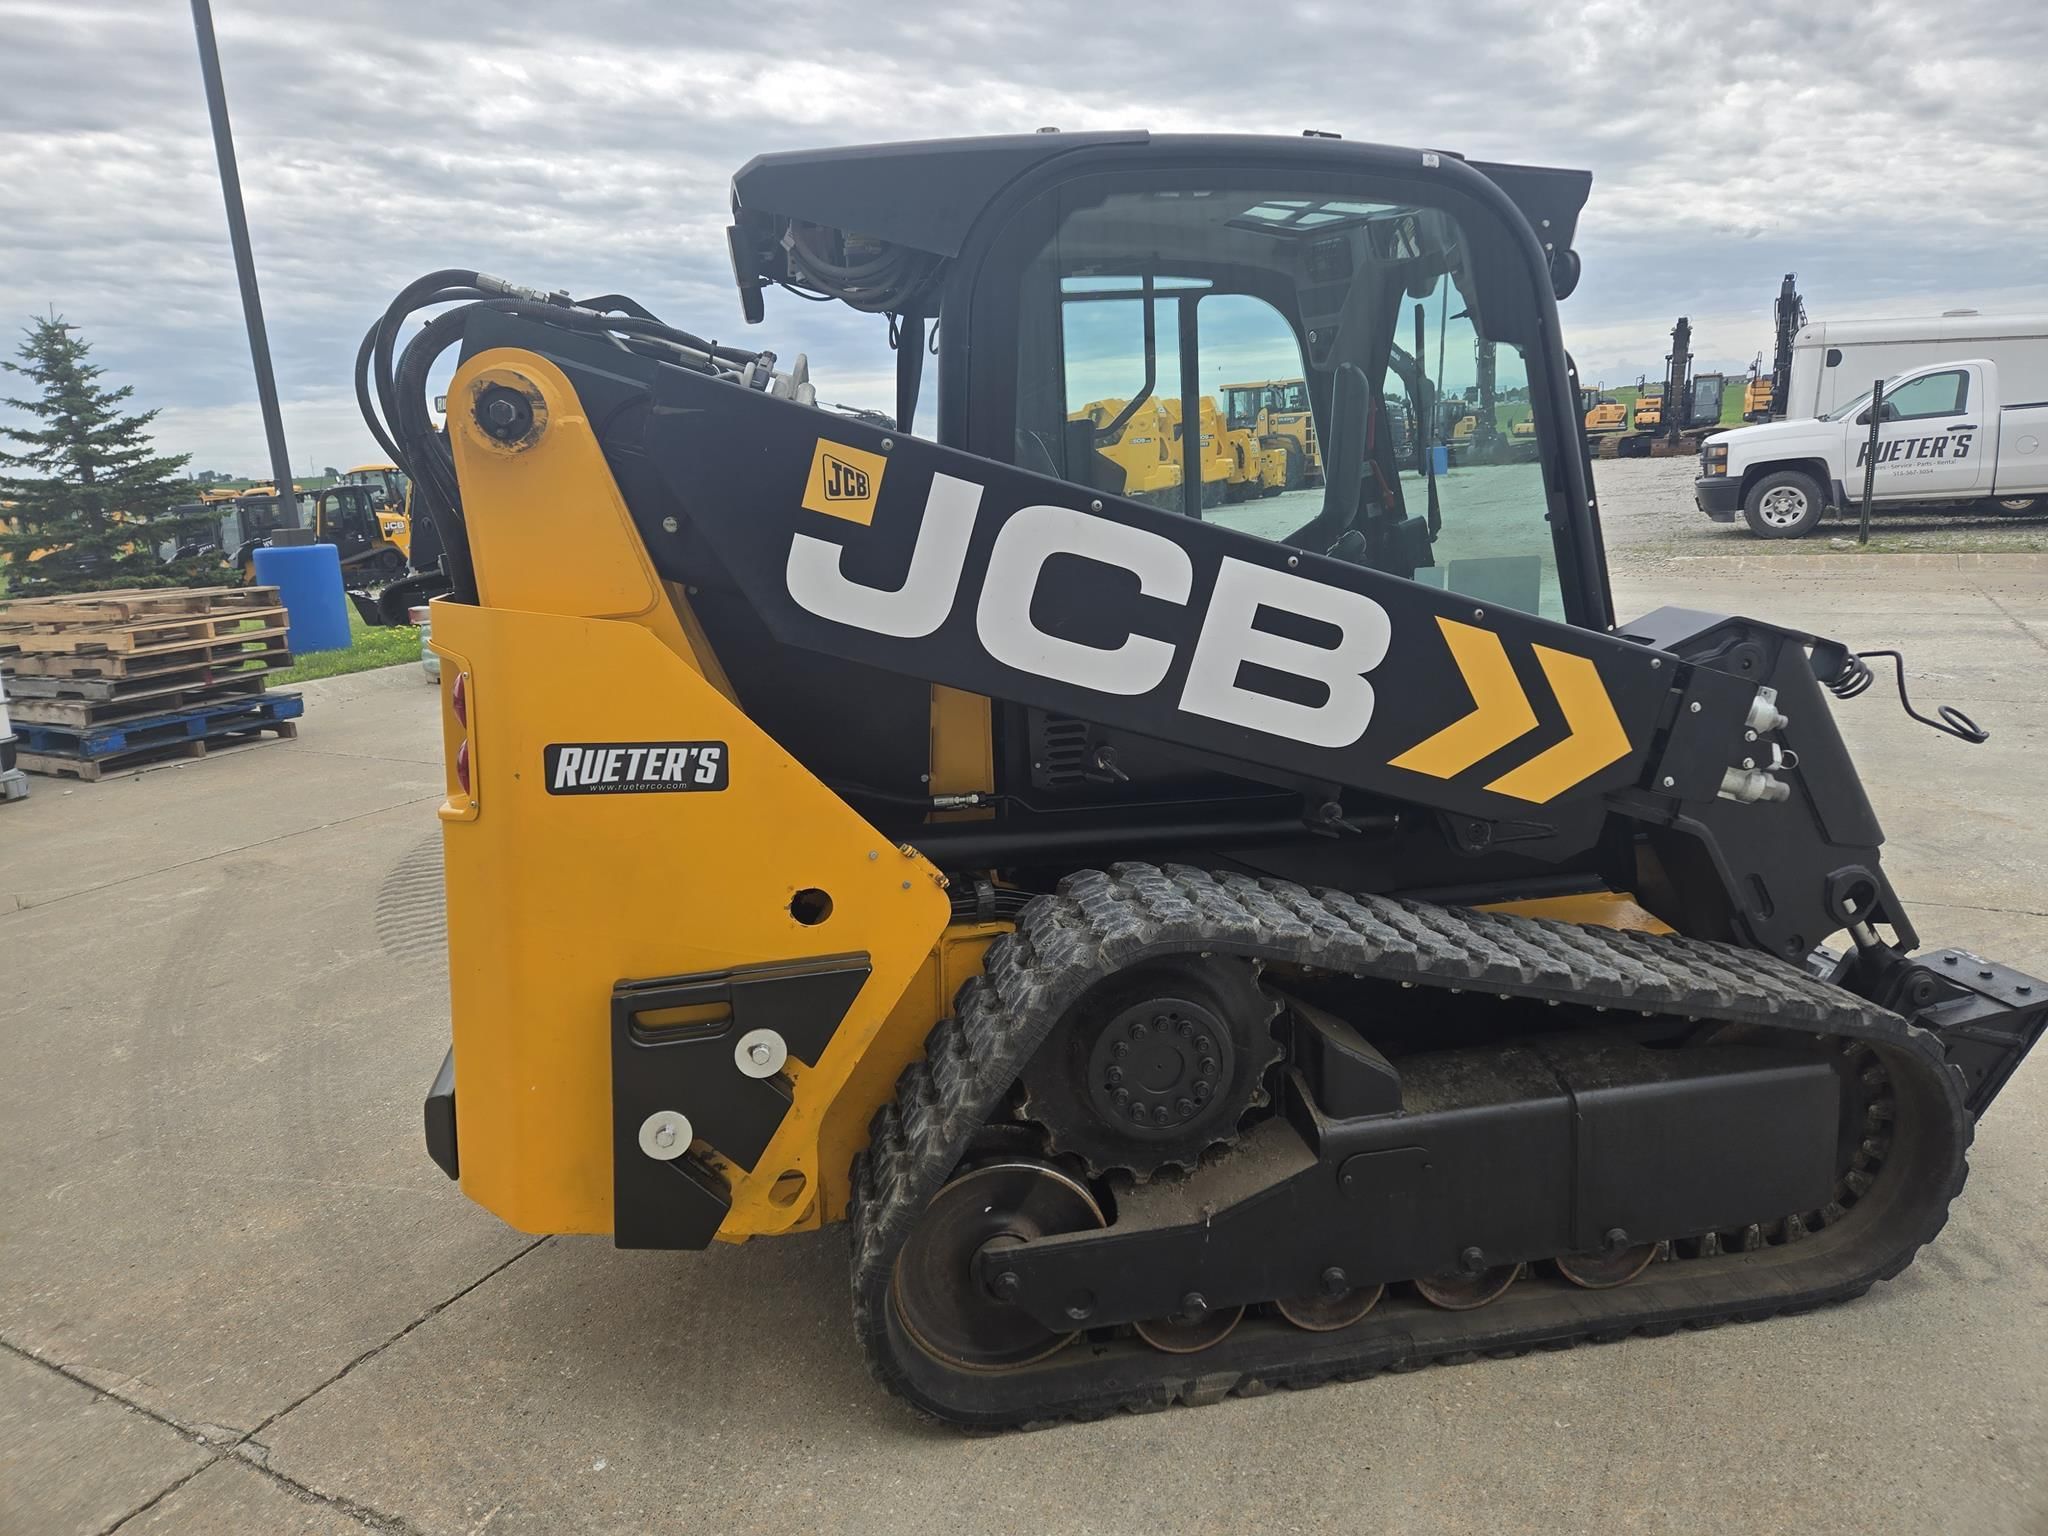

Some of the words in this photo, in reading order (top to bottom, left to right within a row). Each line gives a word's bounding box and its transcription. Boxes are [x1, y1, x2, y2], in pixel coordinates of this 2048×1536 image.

[1891, 462, 1913, 470] Service
[1937, 458, 1957, 466] Rental
[828, 460, 867, 497] JCB
[384, 521, 405, 530] JCB
[786, 472, 1391, 749] JCB
[554, 747, 720, 789] RUETER'S
[589, 782, 687, 792] www.rueterco.com
